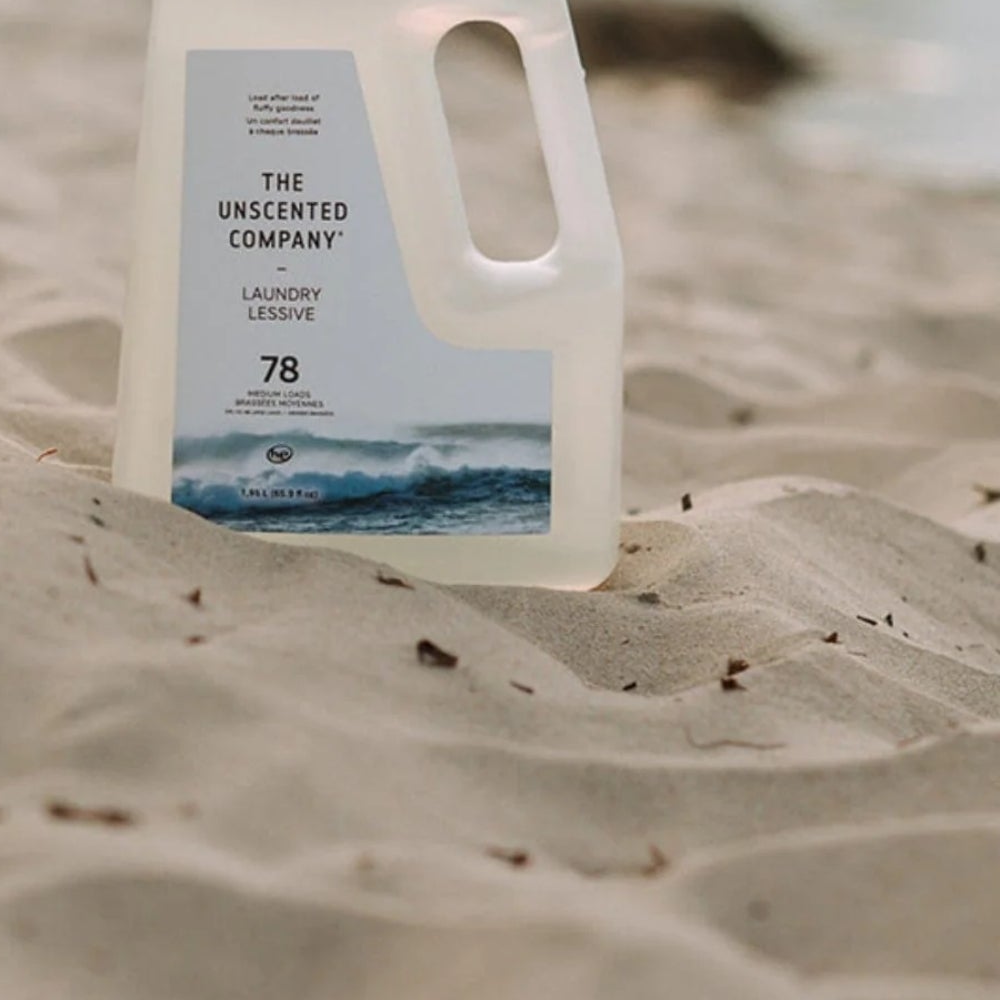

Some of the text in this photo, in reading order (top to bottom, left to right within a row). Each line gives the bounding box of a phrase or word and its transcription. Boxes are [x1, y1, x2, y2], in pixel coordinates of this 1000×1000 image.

[261, 172, 304, 192] THE
[218, 201, 348, 221] UNSCENTED
[242, 286, 322, 301] LAUNDRY
[248, 306, 316, 321] LESSIVE
[260, 356, 299, 383] 78
[284, 390, 311, 398] LOADS
